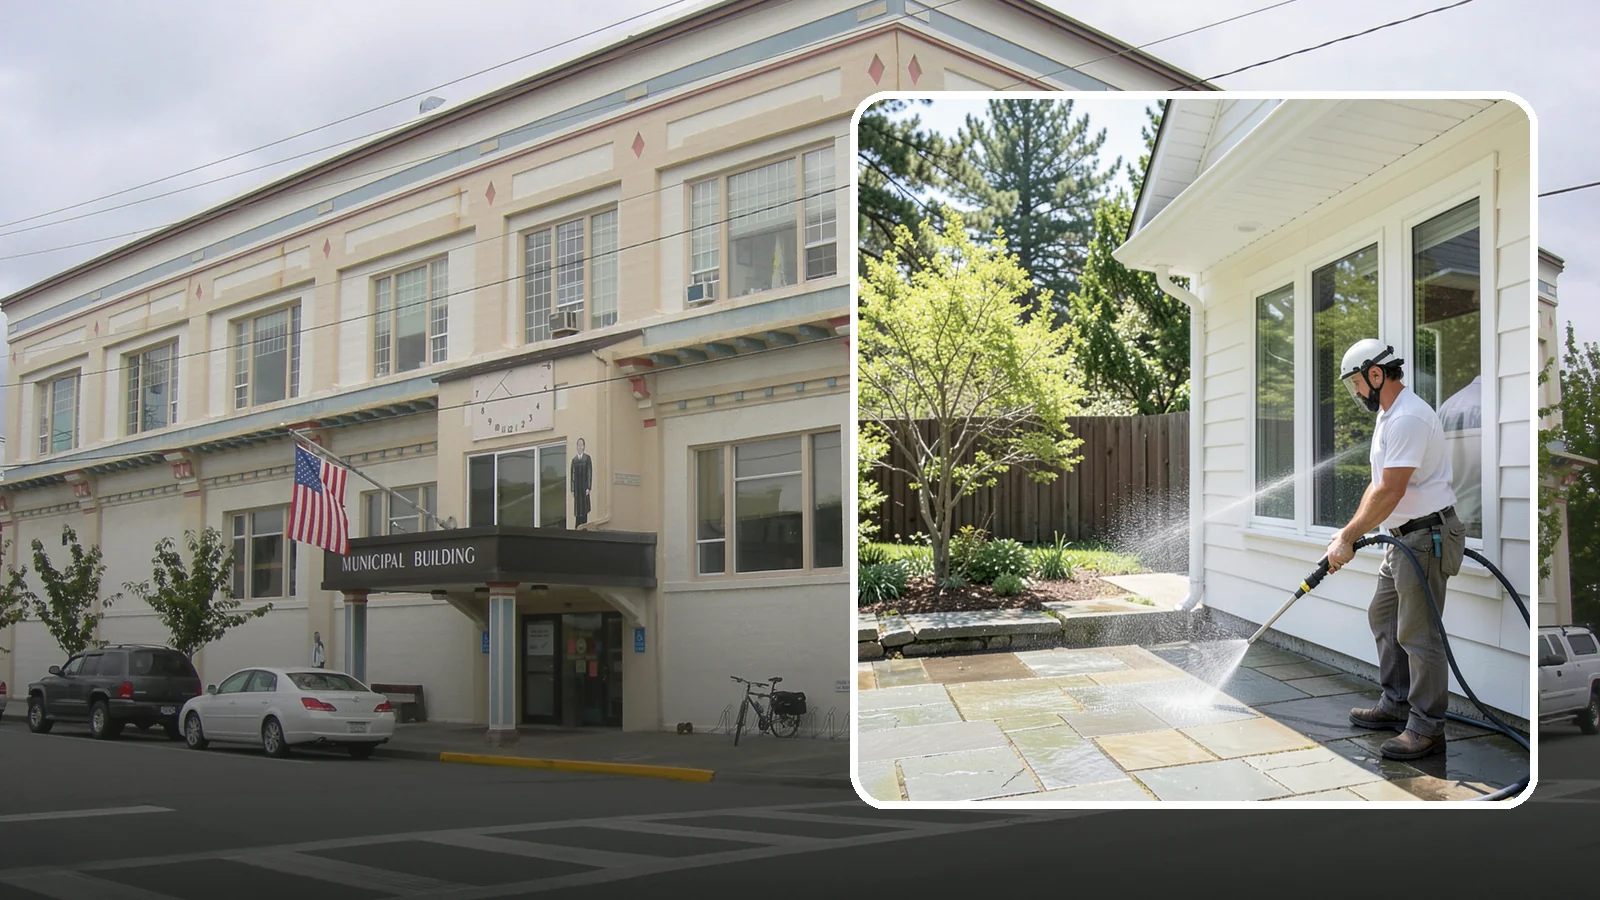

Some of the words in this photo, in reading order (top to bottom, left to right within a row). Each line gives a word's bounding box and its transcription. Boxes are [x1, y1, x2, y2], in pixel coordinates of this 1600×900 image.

[529, 414, 532, 422] 3
[342, 552, 405, 572] MUNICIPAL
[414, 546, 475, 567] BUILDING
